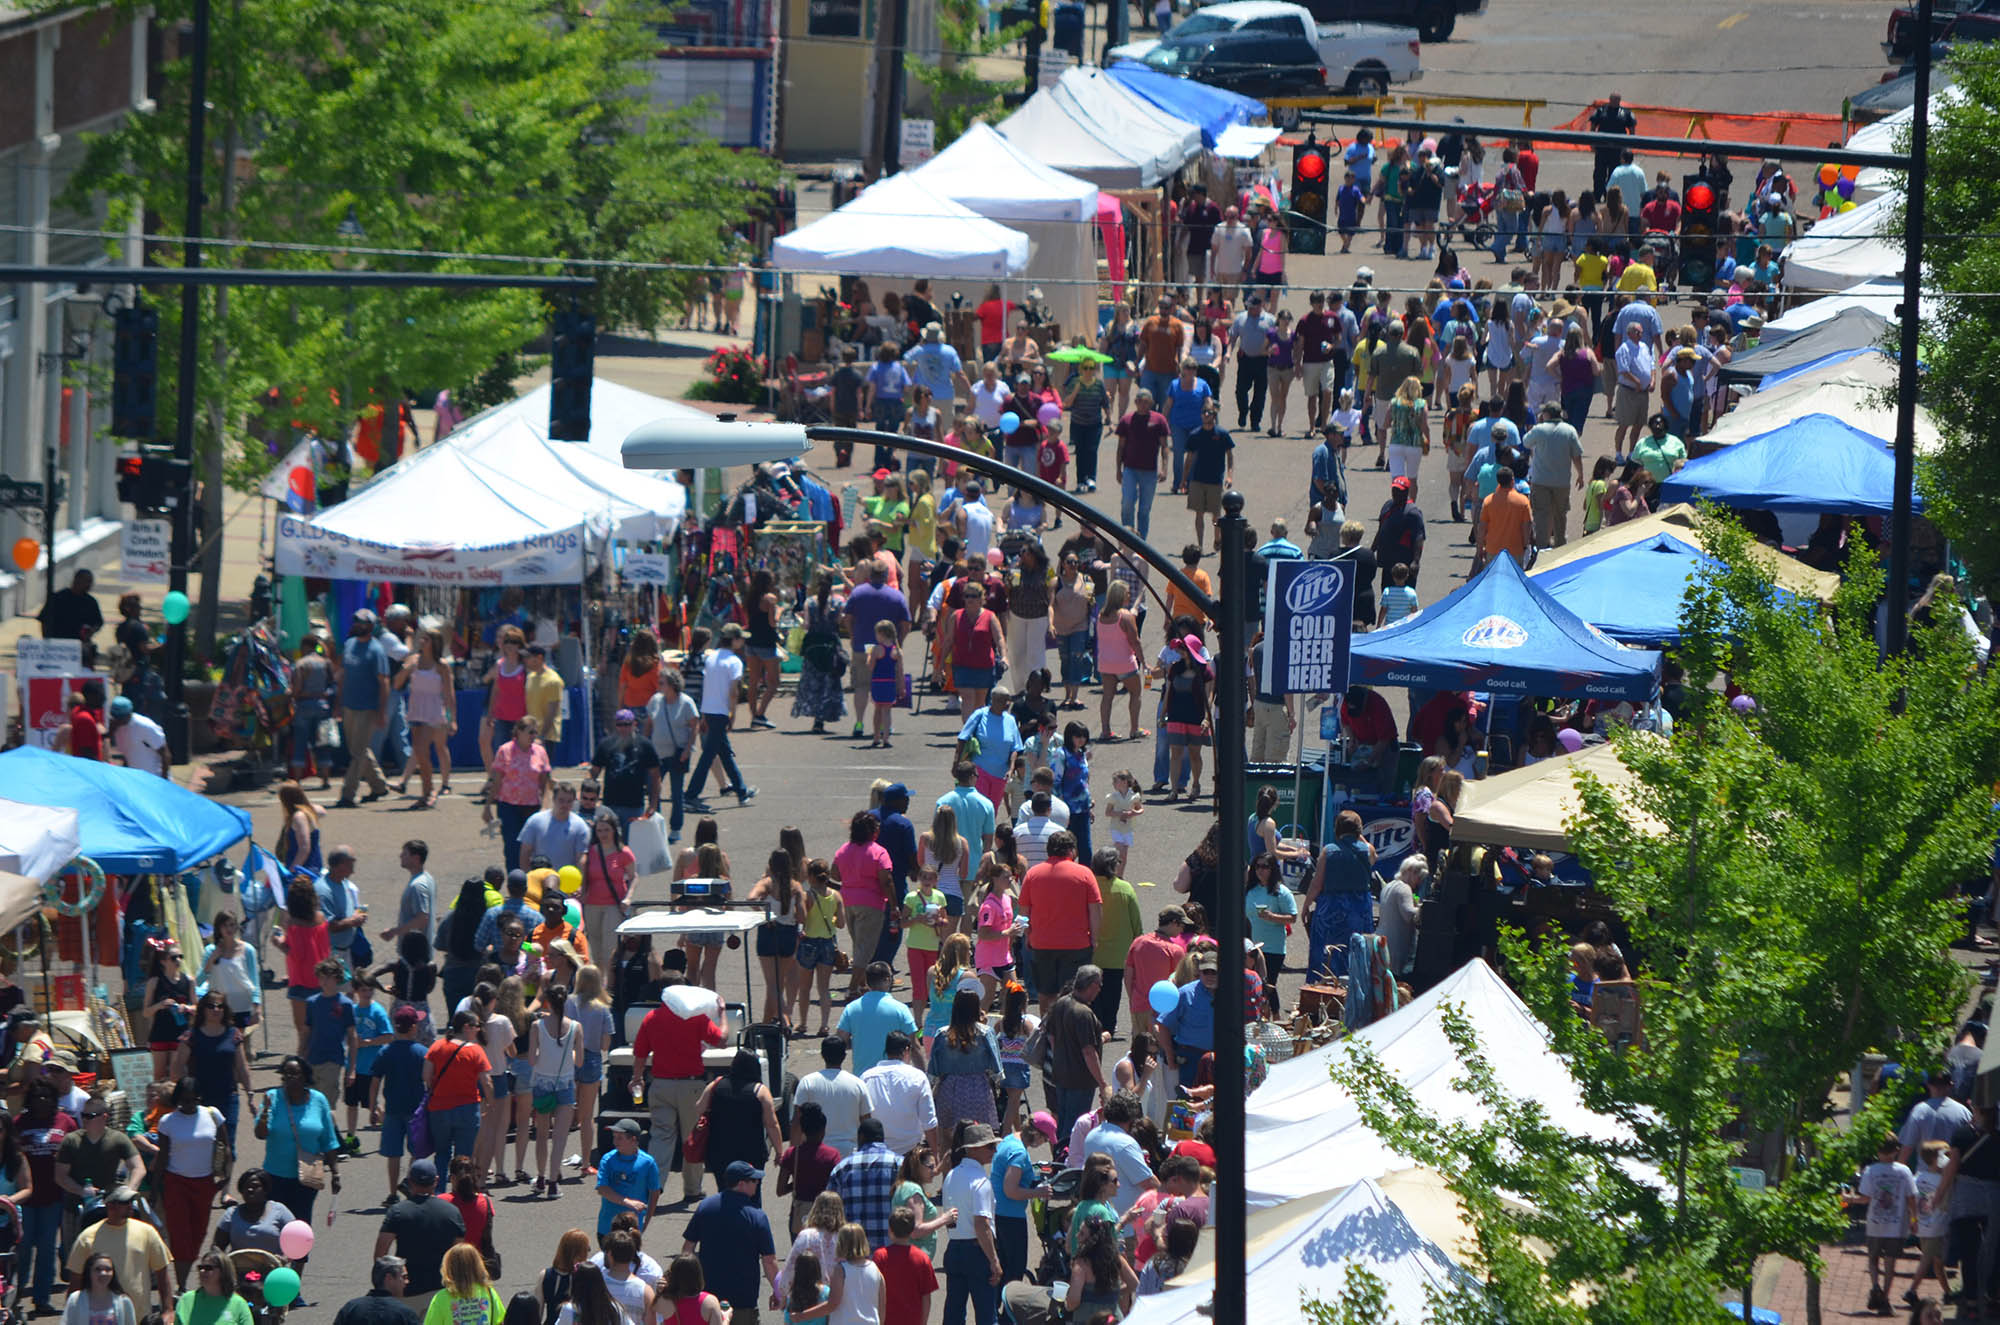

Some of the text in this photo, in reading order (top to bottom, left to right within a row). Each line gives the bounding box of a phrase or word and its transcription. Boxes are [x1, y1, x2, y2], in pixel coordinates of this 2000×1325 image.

[523, 532, 577, 555] Rings
[428, 566, 463, 581] Yours
[467, 565, 503, 583] Today
[1292, 572, 1337, 613] Lite
[1290, 615, 1335, 640] COLD
[1289, 640, 1334, 665] BEER
[1287, 664, 1332, 690] HERE
[1387, 671, 1410, 682] Good
[1487, 678, 1510, 688] Good
[1585, 684, 1608, 694] Good
